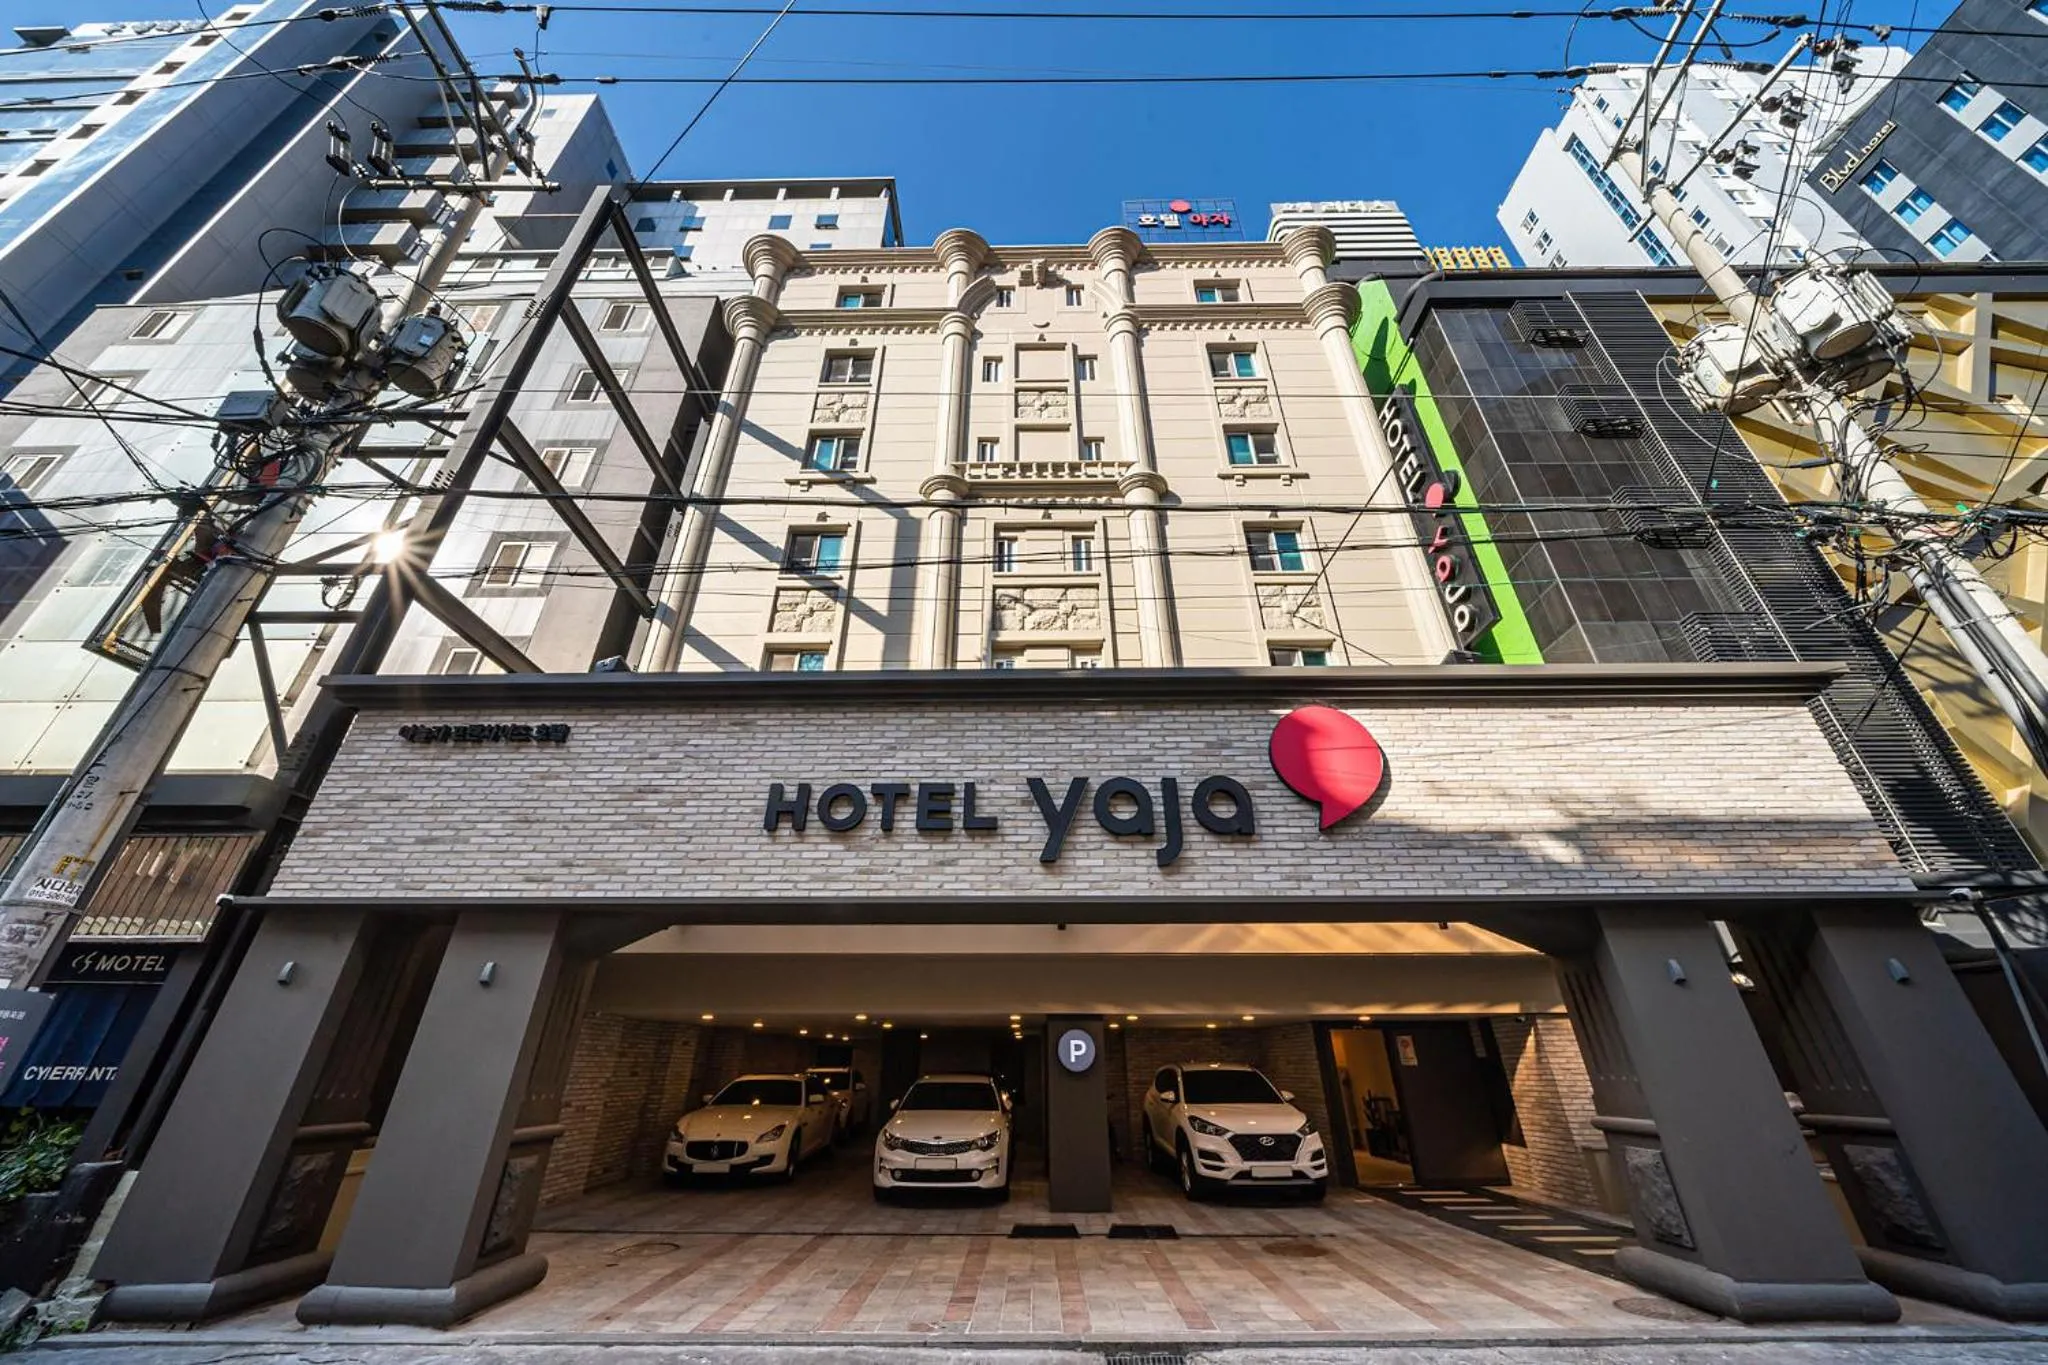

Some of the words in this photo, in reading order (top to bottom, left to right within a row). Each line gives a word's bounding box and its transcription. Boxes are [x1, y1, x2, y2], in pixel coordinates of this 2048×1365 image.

[1820, 150, 1860, 193] Blvd
[1138, 213, 1180, 228] 호텔
[1188, 211, 1231, 227] 야자
[1379, 396, 1426, 502] HOTEL
[763, 782, 998, 833] HOTEL
[95, 956, 165, 971] MOTEL
[1070, 1039, 1086, 1062] P
